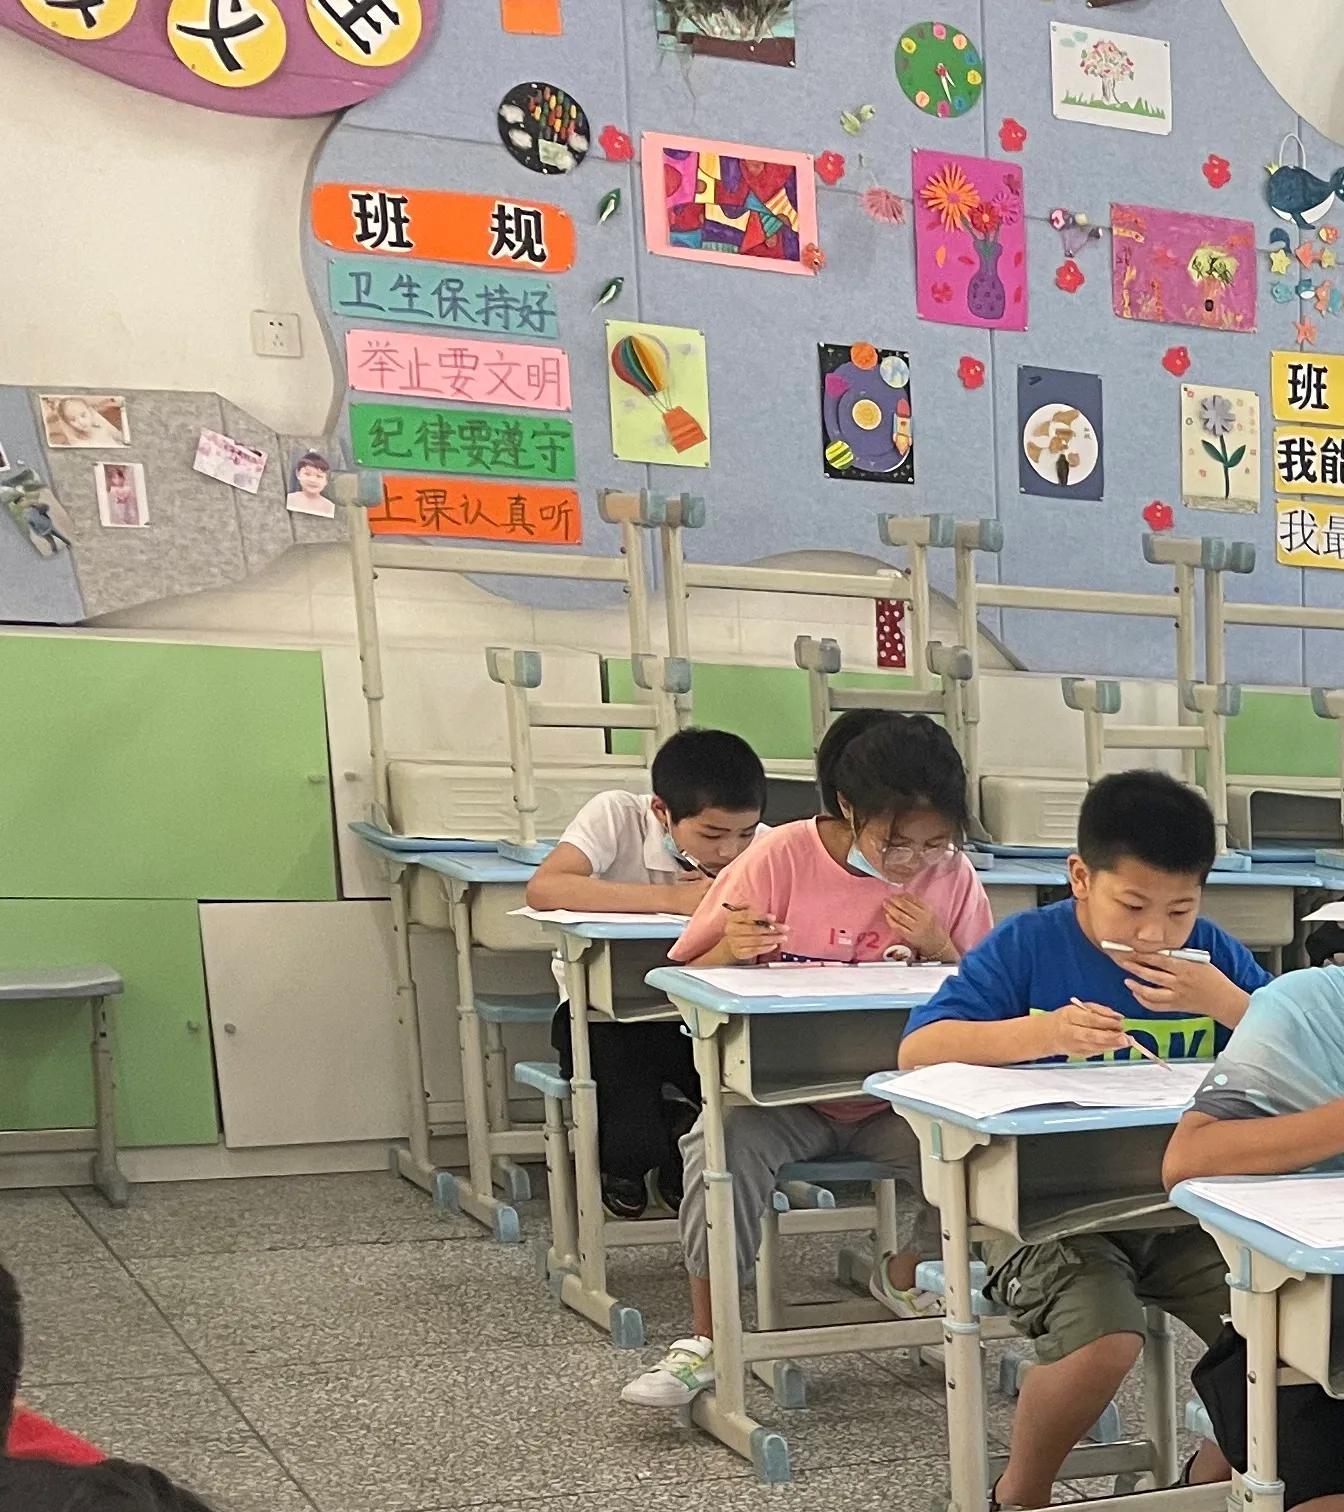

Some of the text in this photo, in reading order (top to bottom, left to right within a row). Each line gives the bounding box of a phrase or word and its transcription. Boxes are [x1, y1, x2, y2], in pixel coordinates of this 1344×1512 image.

[351, 192, 547, 264] 班规
[339, 271, 556, 333] 卫生保持好
[358, 340, 562, 406] 举止要文明
[368, 413, 571, 474] 纪律要遵守
[369, 483, 574, 541] 上课认真听
